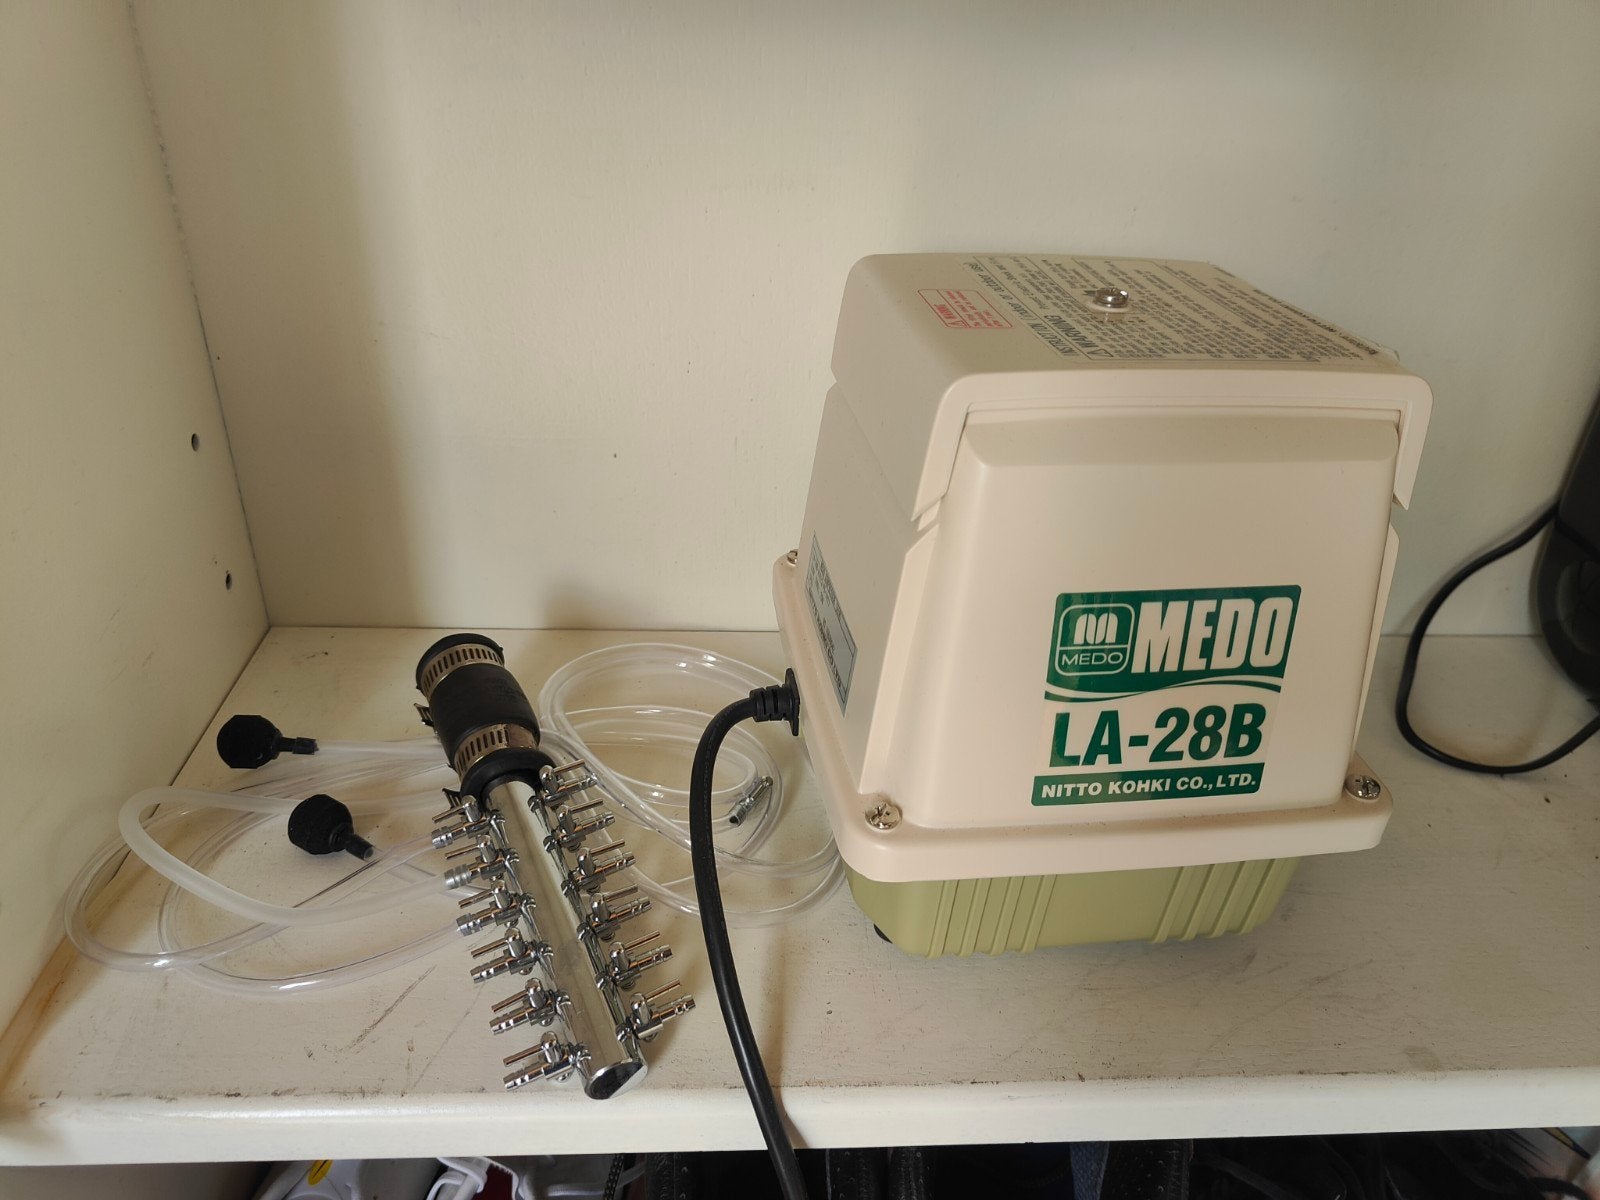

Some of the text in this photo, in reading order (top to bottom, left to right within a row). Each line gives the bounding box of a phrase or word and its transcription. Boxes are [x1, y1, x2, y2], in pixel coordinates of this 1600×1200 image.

[1044, 315, 1099, 348] WARNING
[1131, 597, 1293, 674] MEDO
[1061, 652, 1123, 666] MEDO
[1049, 703, 1267, 768] LA-28B
[1041, 782, 1103, 799] NITTO
[1108, 778, 1170, 795] KOHKI
